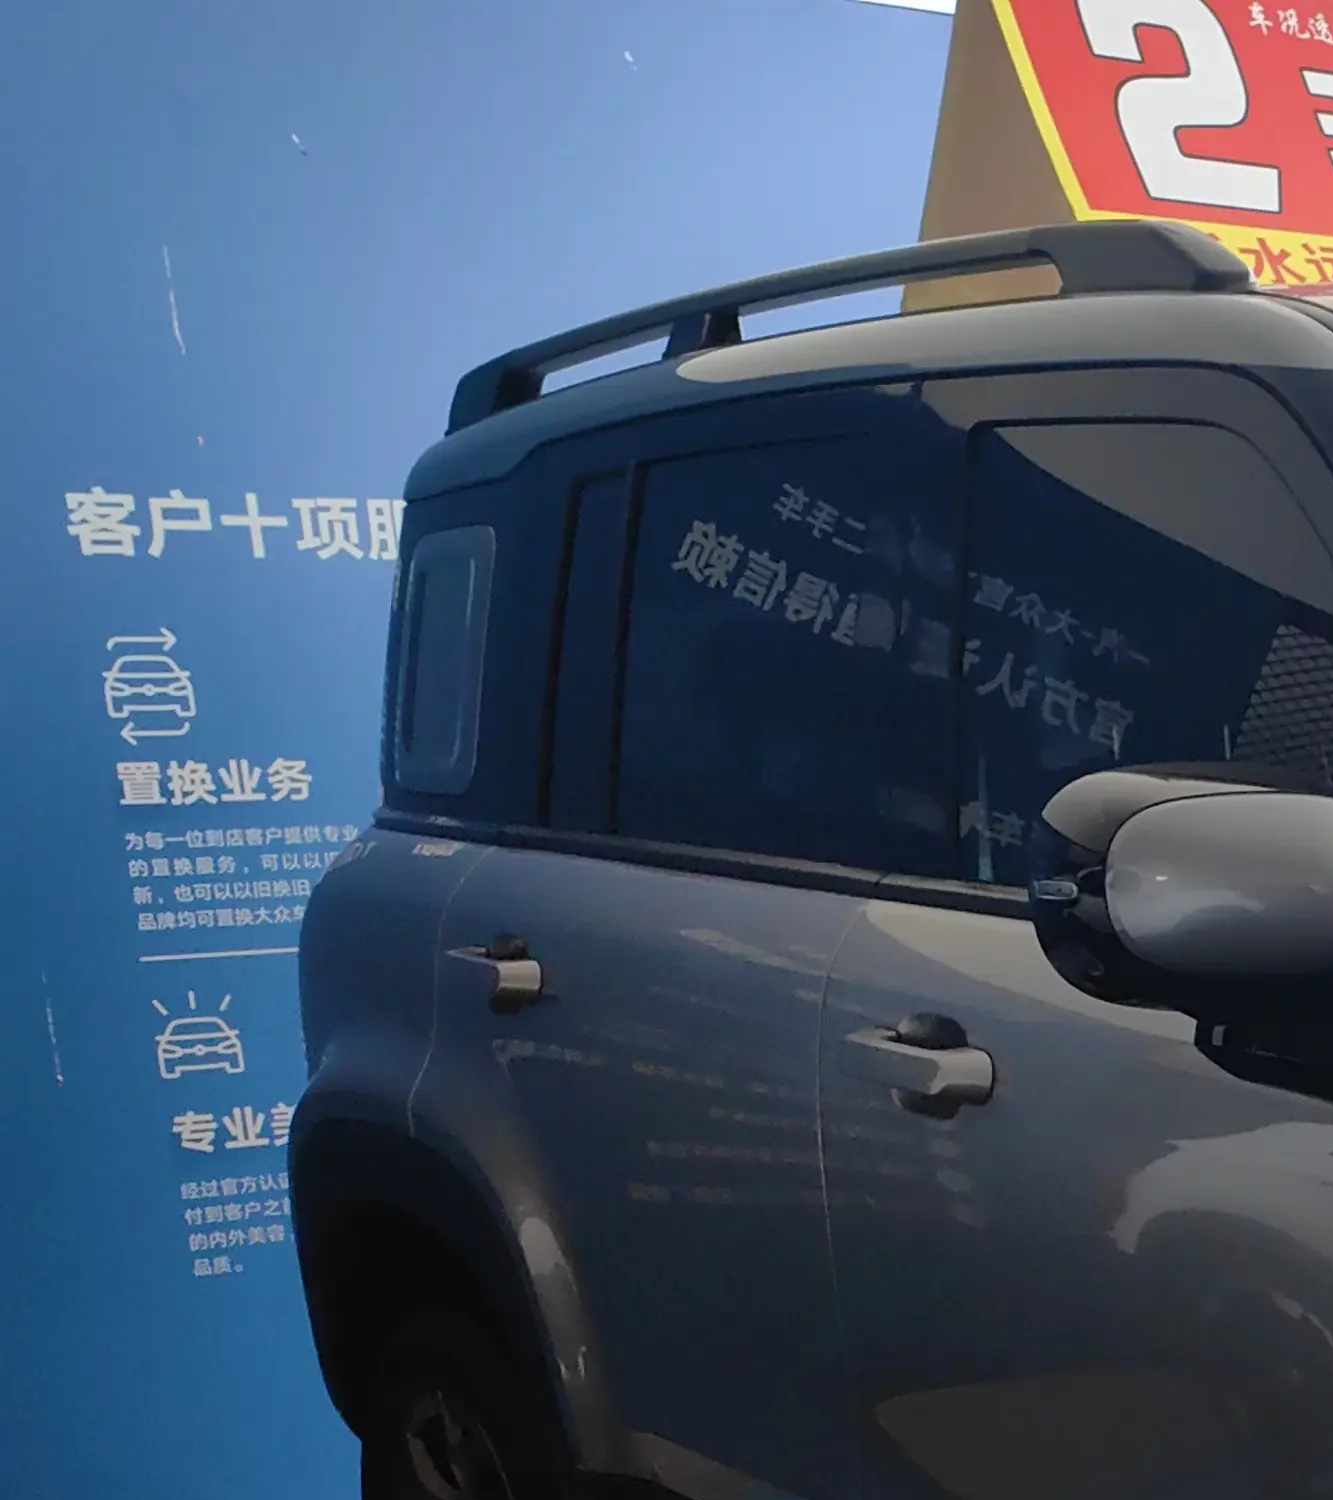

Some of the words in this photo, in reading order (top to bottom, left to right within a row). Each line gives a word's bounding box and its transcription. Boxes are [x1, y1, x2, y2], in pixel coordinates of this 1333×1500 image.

[116, 757, 313, 807] 置换业务
[125, 825, 359, 852] 为每一位到店客户提供专业
